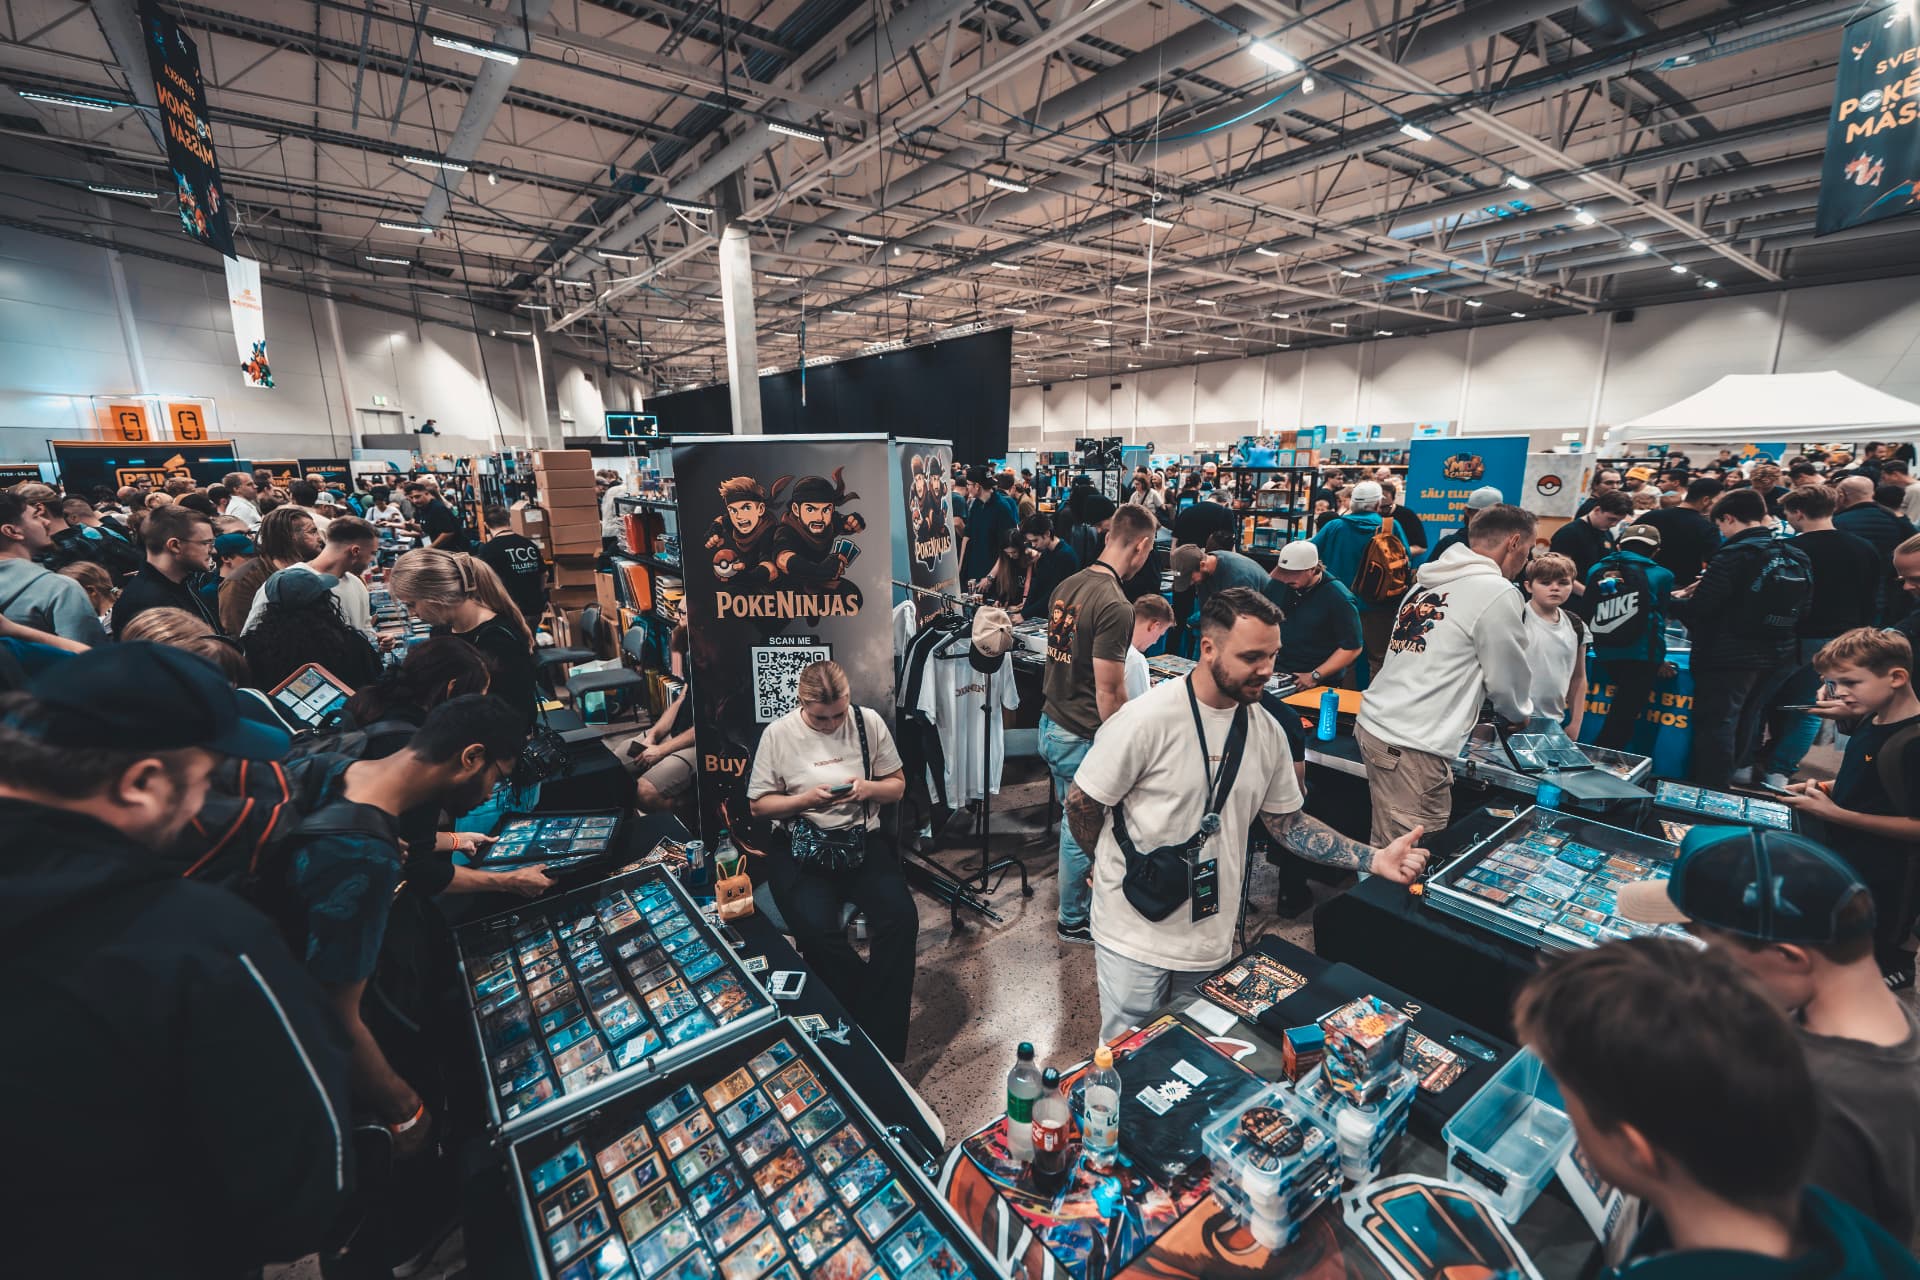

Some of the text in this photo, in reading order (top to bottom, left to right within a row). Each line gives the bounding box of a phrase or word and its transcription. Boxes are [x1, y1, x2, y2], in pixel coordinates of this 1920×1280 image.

[1875, 46, 1920, 75] SVE
[1845, 101, 1920, 143] MÄS
[1596, 591, 1639, 622] NIKE
[769, 637, 811, 645] SCAN ME
[1647, 709, 1688, 728] HOS
[705, 754, 747, 777] Buy
